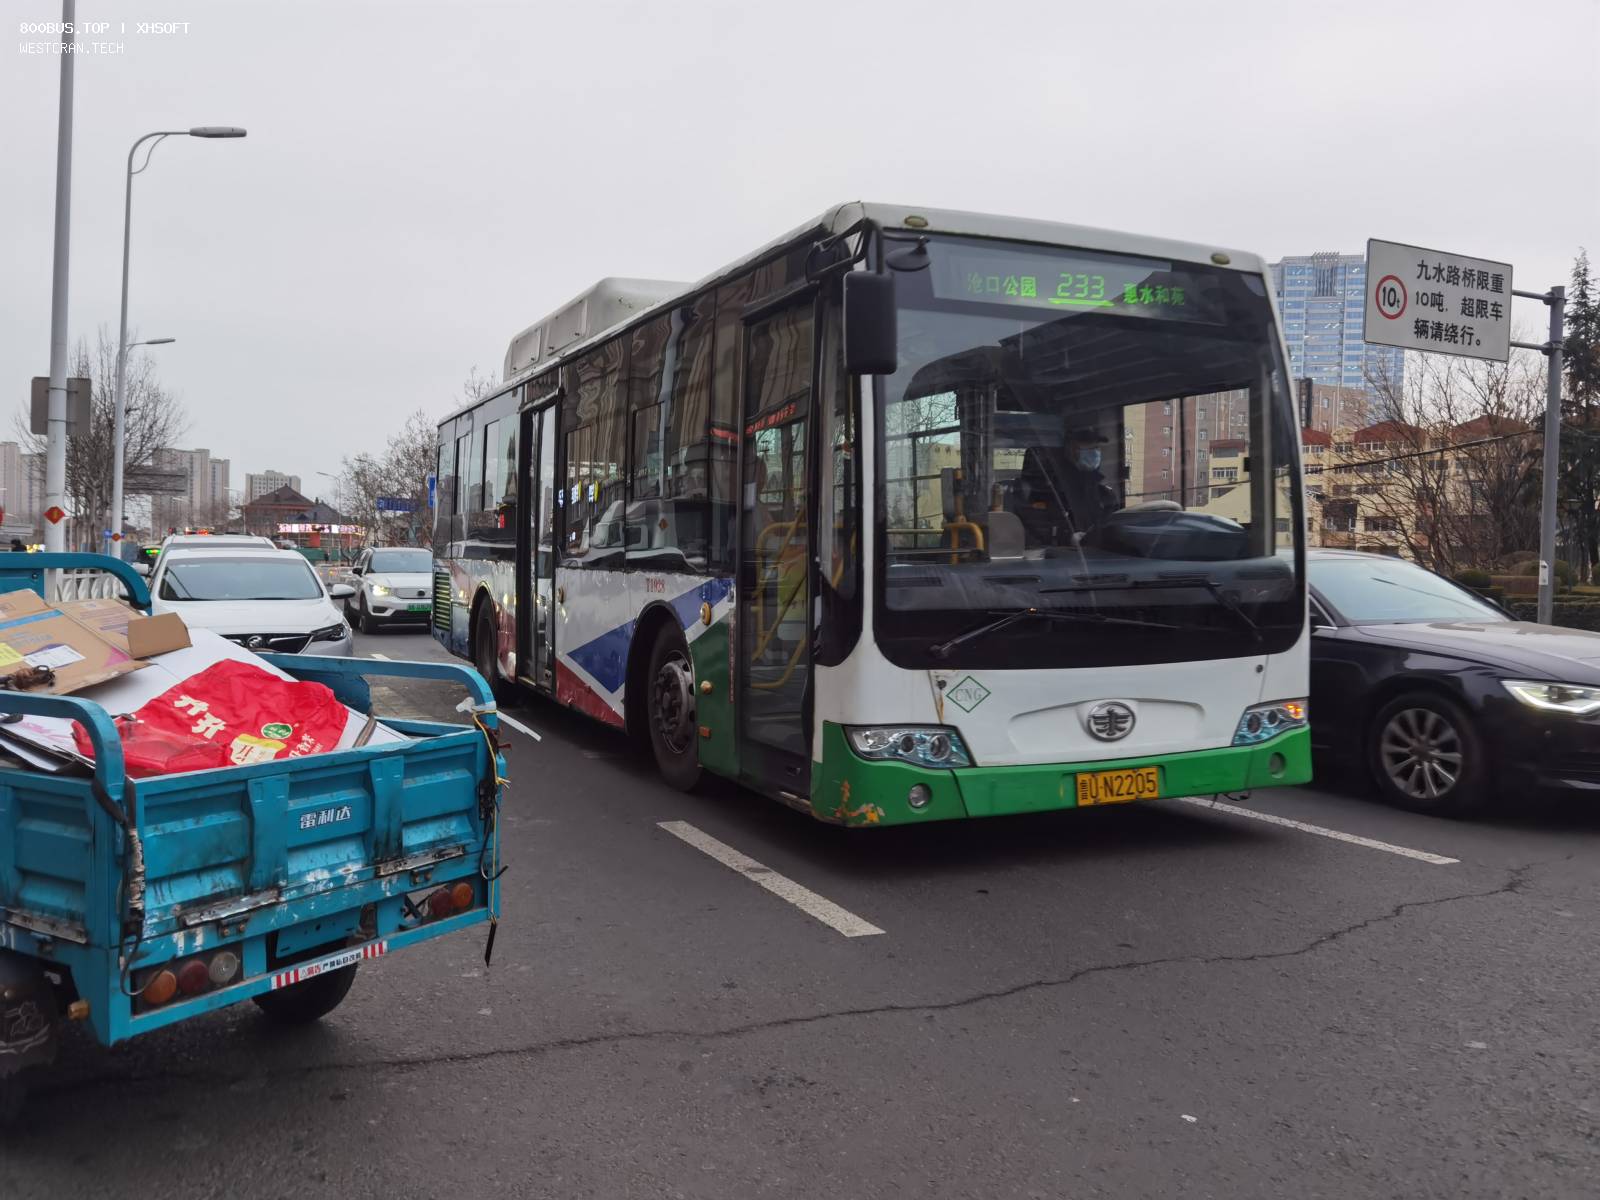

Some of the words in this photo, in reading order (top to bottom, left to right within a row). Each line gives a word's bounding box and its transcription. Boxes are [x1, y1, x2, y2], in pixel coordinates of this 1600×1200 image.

[1056, 273, 1105, 298] 233
[1416, 259, 1504, 294] 九水路桥限重
[955, 687, 983, 702] CNG
[300, 805, 352, 830] 雷利达
